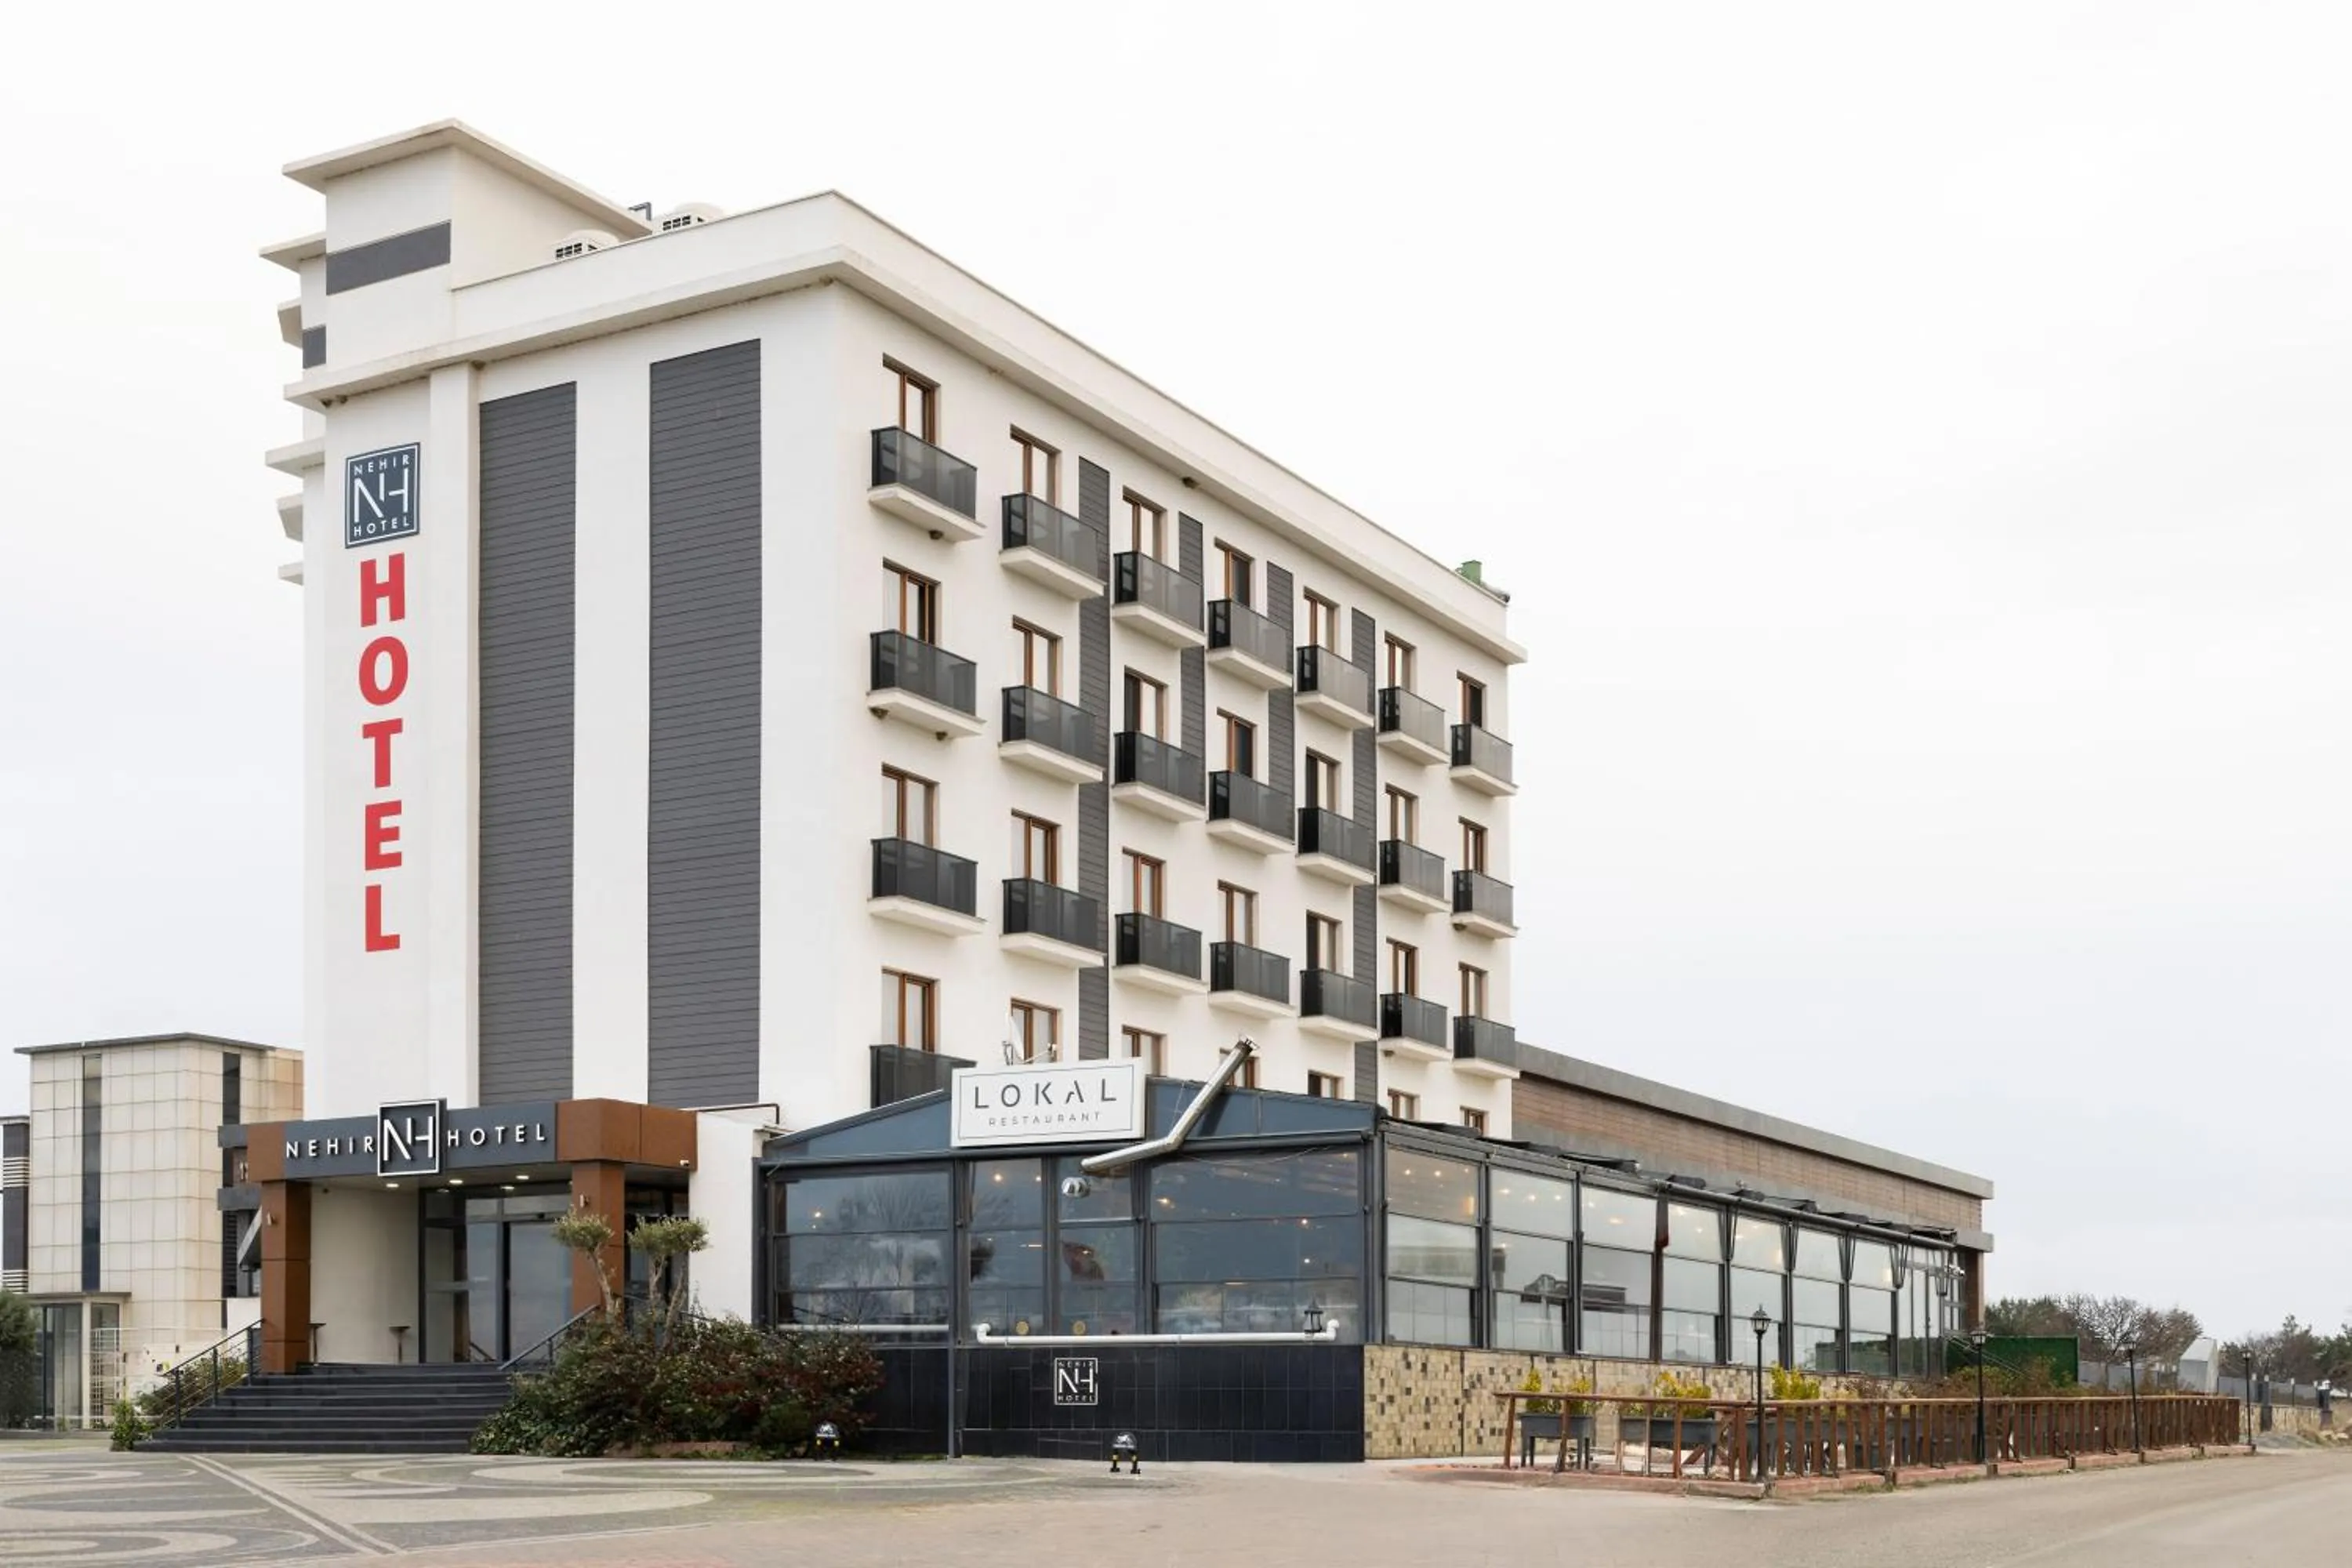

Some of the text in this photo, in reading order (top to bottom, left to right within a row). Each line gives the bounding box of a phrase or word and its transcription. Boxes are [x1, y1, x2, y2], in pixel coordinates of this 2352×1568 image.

[354, 454, 410, 476] NEHIR
[354, 466, 409, 523] NH
[354, 516, 410, 537] HOTEL
[358, 552, 408, 953] HOTEL
[975, 1078, 1117, 1109] LOKAL
[989, 1111, 1102, 1127] RESTAURANT
[285, 1135, 376, 1158] NEHIR
[447, 1123, 546, 1149] HOTEL
